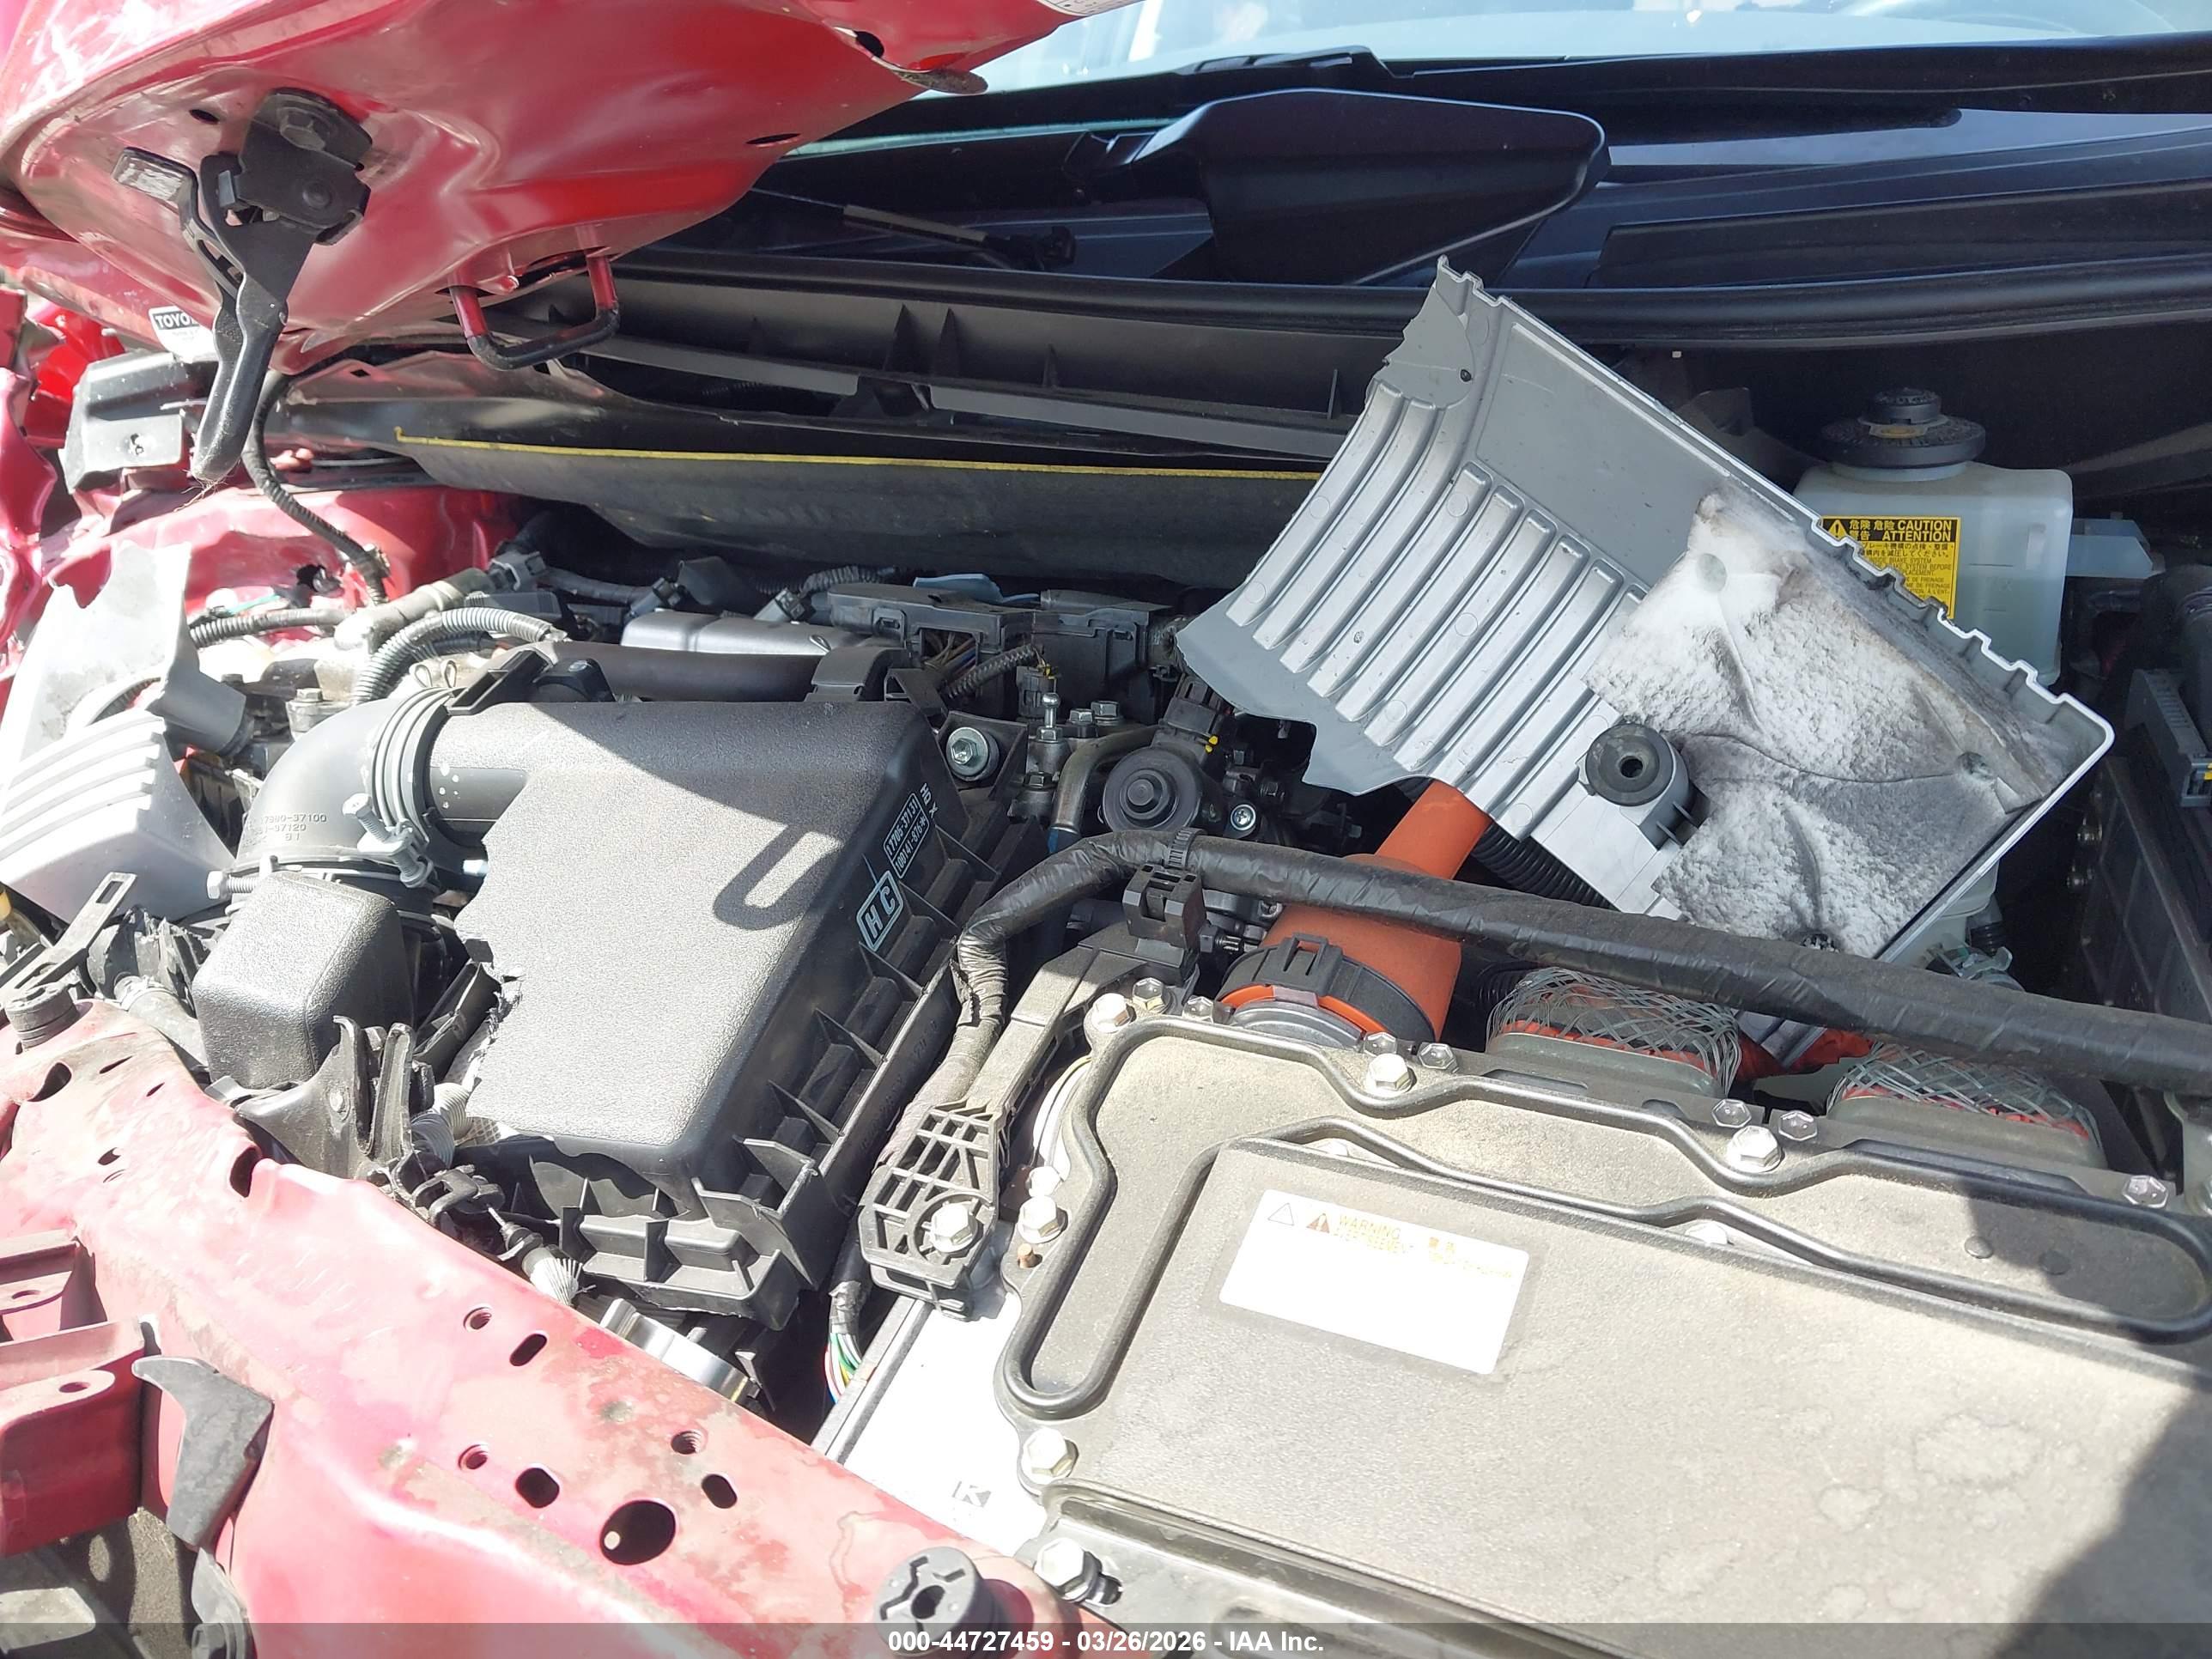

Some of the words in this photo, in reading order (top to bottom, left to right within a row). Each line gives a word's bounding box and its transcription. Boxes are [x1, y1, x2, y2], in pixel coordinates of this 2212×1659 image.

[155, 312, 193, 329] TOYO
[1897, 520, 1952, 532] CAUTION
[1881, 531, 1951, 542] ATTENTION
[885, 798, 919, 855] 17705-37131
